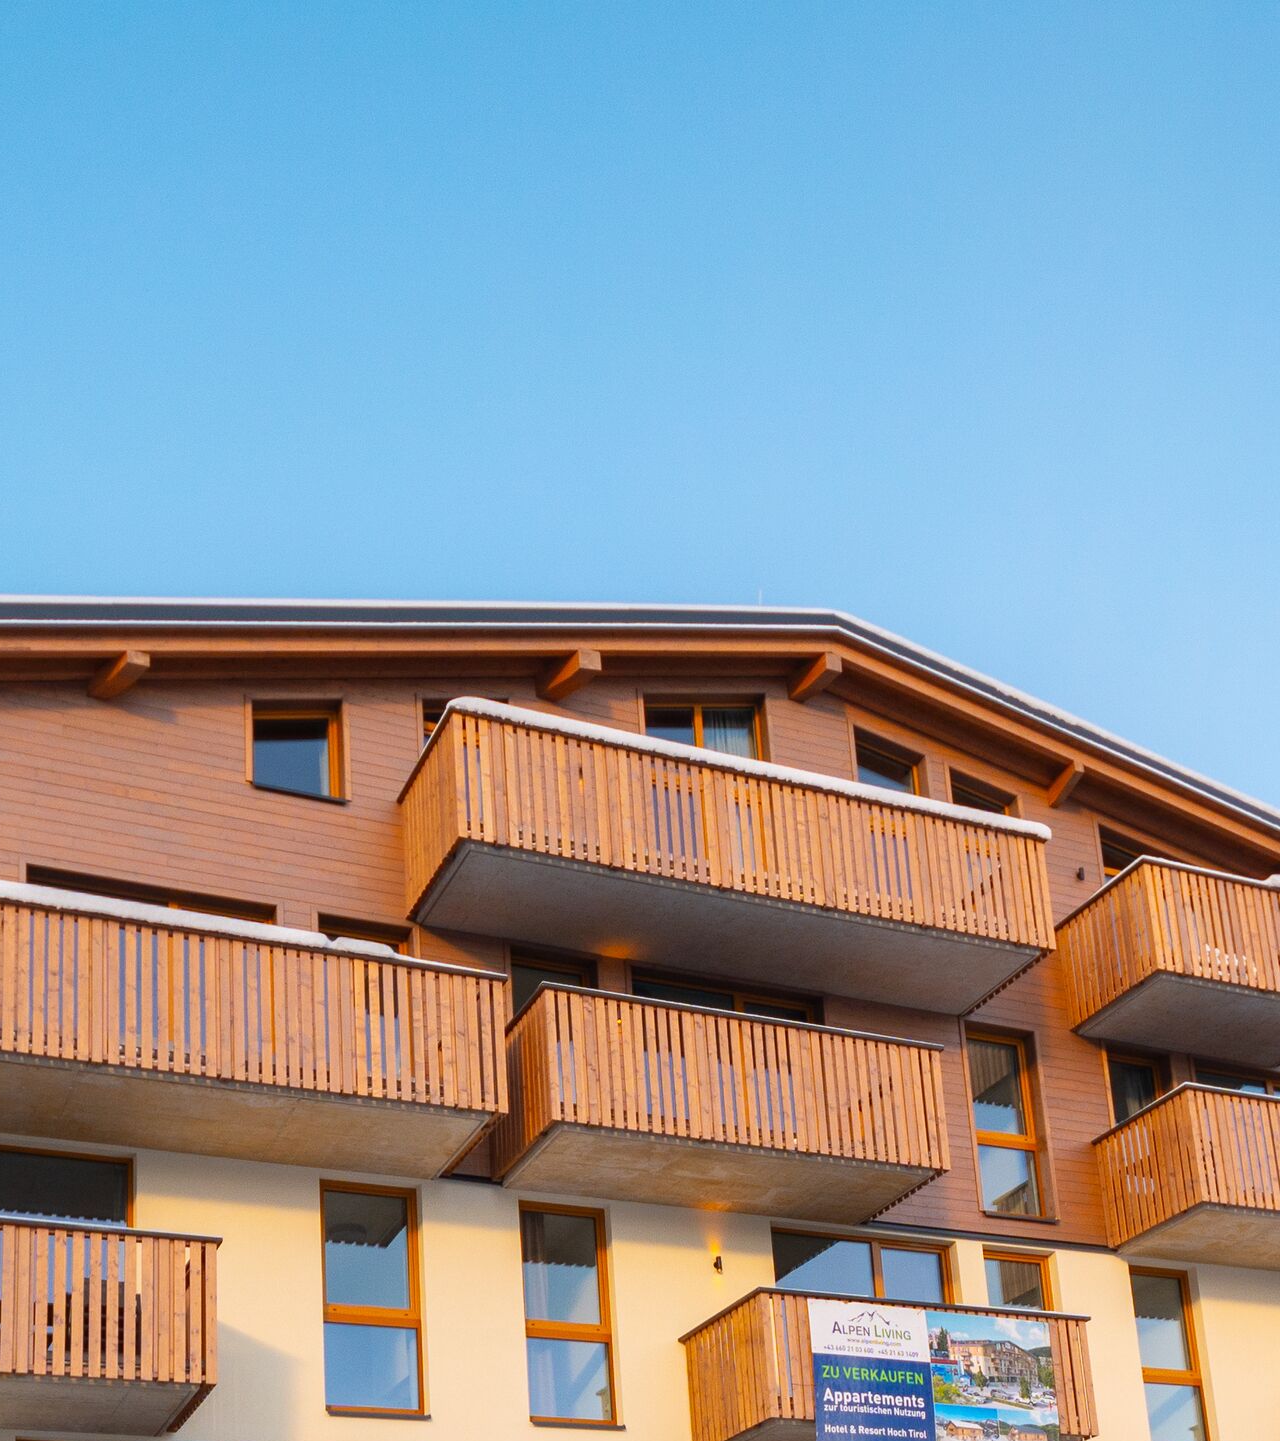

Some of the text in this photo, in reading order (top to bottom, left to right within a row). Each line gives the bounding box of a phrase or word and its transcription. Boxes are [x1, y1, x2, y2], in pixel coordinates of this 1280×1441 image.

[832, 1321, 912, 1341] ALPEN LIVING
[822, 1365, 924, 1385] ZU VERKAUFEN
[823, 1387, 926, 1408] Appartements
[824, 1404, 926, 1420] zur touristischen Nutzung
[824, 1424, 927, 1439] Hotel & Resort Hoch Tirol
